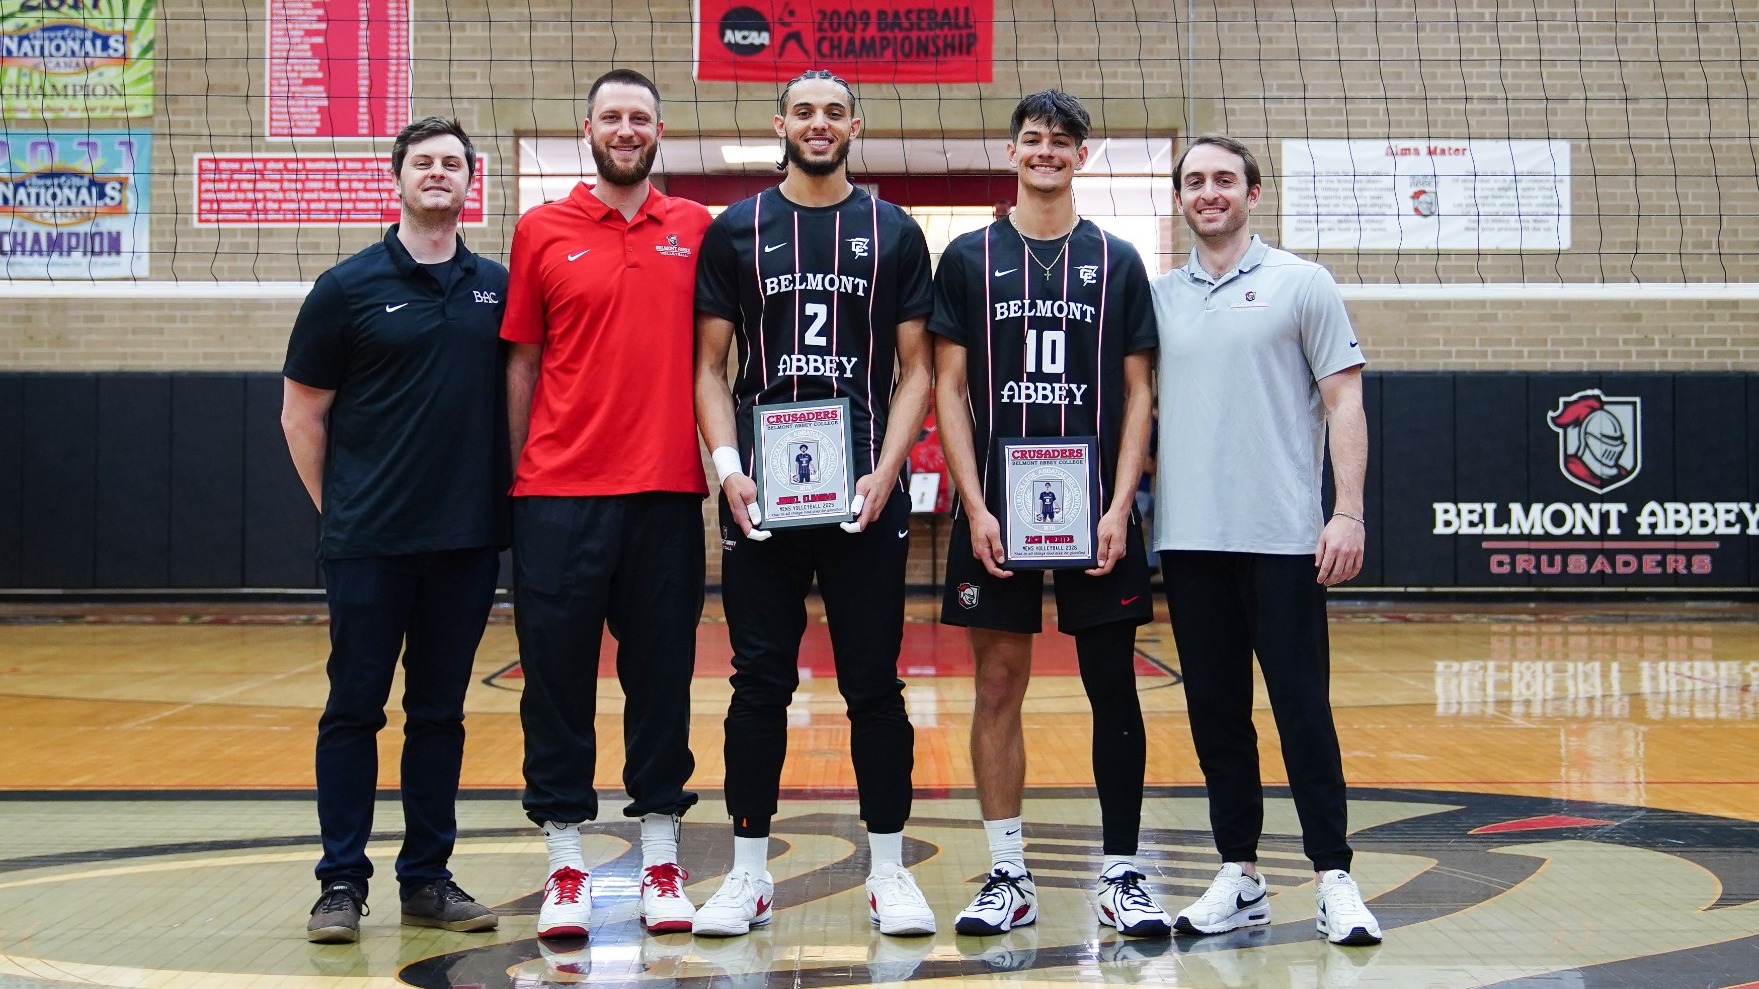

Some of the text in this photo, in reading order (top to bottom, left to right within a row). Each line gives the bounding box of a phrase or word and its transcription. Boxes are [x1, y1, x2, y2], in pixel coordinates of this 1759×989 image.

[816, 7, 974, 33] 2009 BASEBALL
[3, 34, 126, 58] NATIONALS
[723, 28, 770, 46] NCAA
[816, 33, 978, 59] CHAMPIONSHIP
[2, 82, 125, 101] CHAMPION
[1385, 146, 1468, 157] Alma Mater
[0, 180, 122, 206] NATIONALS
[0, 231, 121, 257] CHAMPION
[765, 273, 868, 296] BELMONT
[473, 290, 499, 304] BAC
[994, 299, 1096, 323] BELMONT
[804, 302, 828, 346] 2
[1025, 329, 1066, 374] 10
[777, 354, 858, 378] ABBEY
[1001, 381, 1087, 405] ABBEY
[767, 410, 838, 424] CRUSADERS
[1012, 448, 1083, 459] CRUSADERS
[1432, 500, 1759, 535] BELMONT ABBEY
[1489, 553, 1713, 575] CRUSADERS
